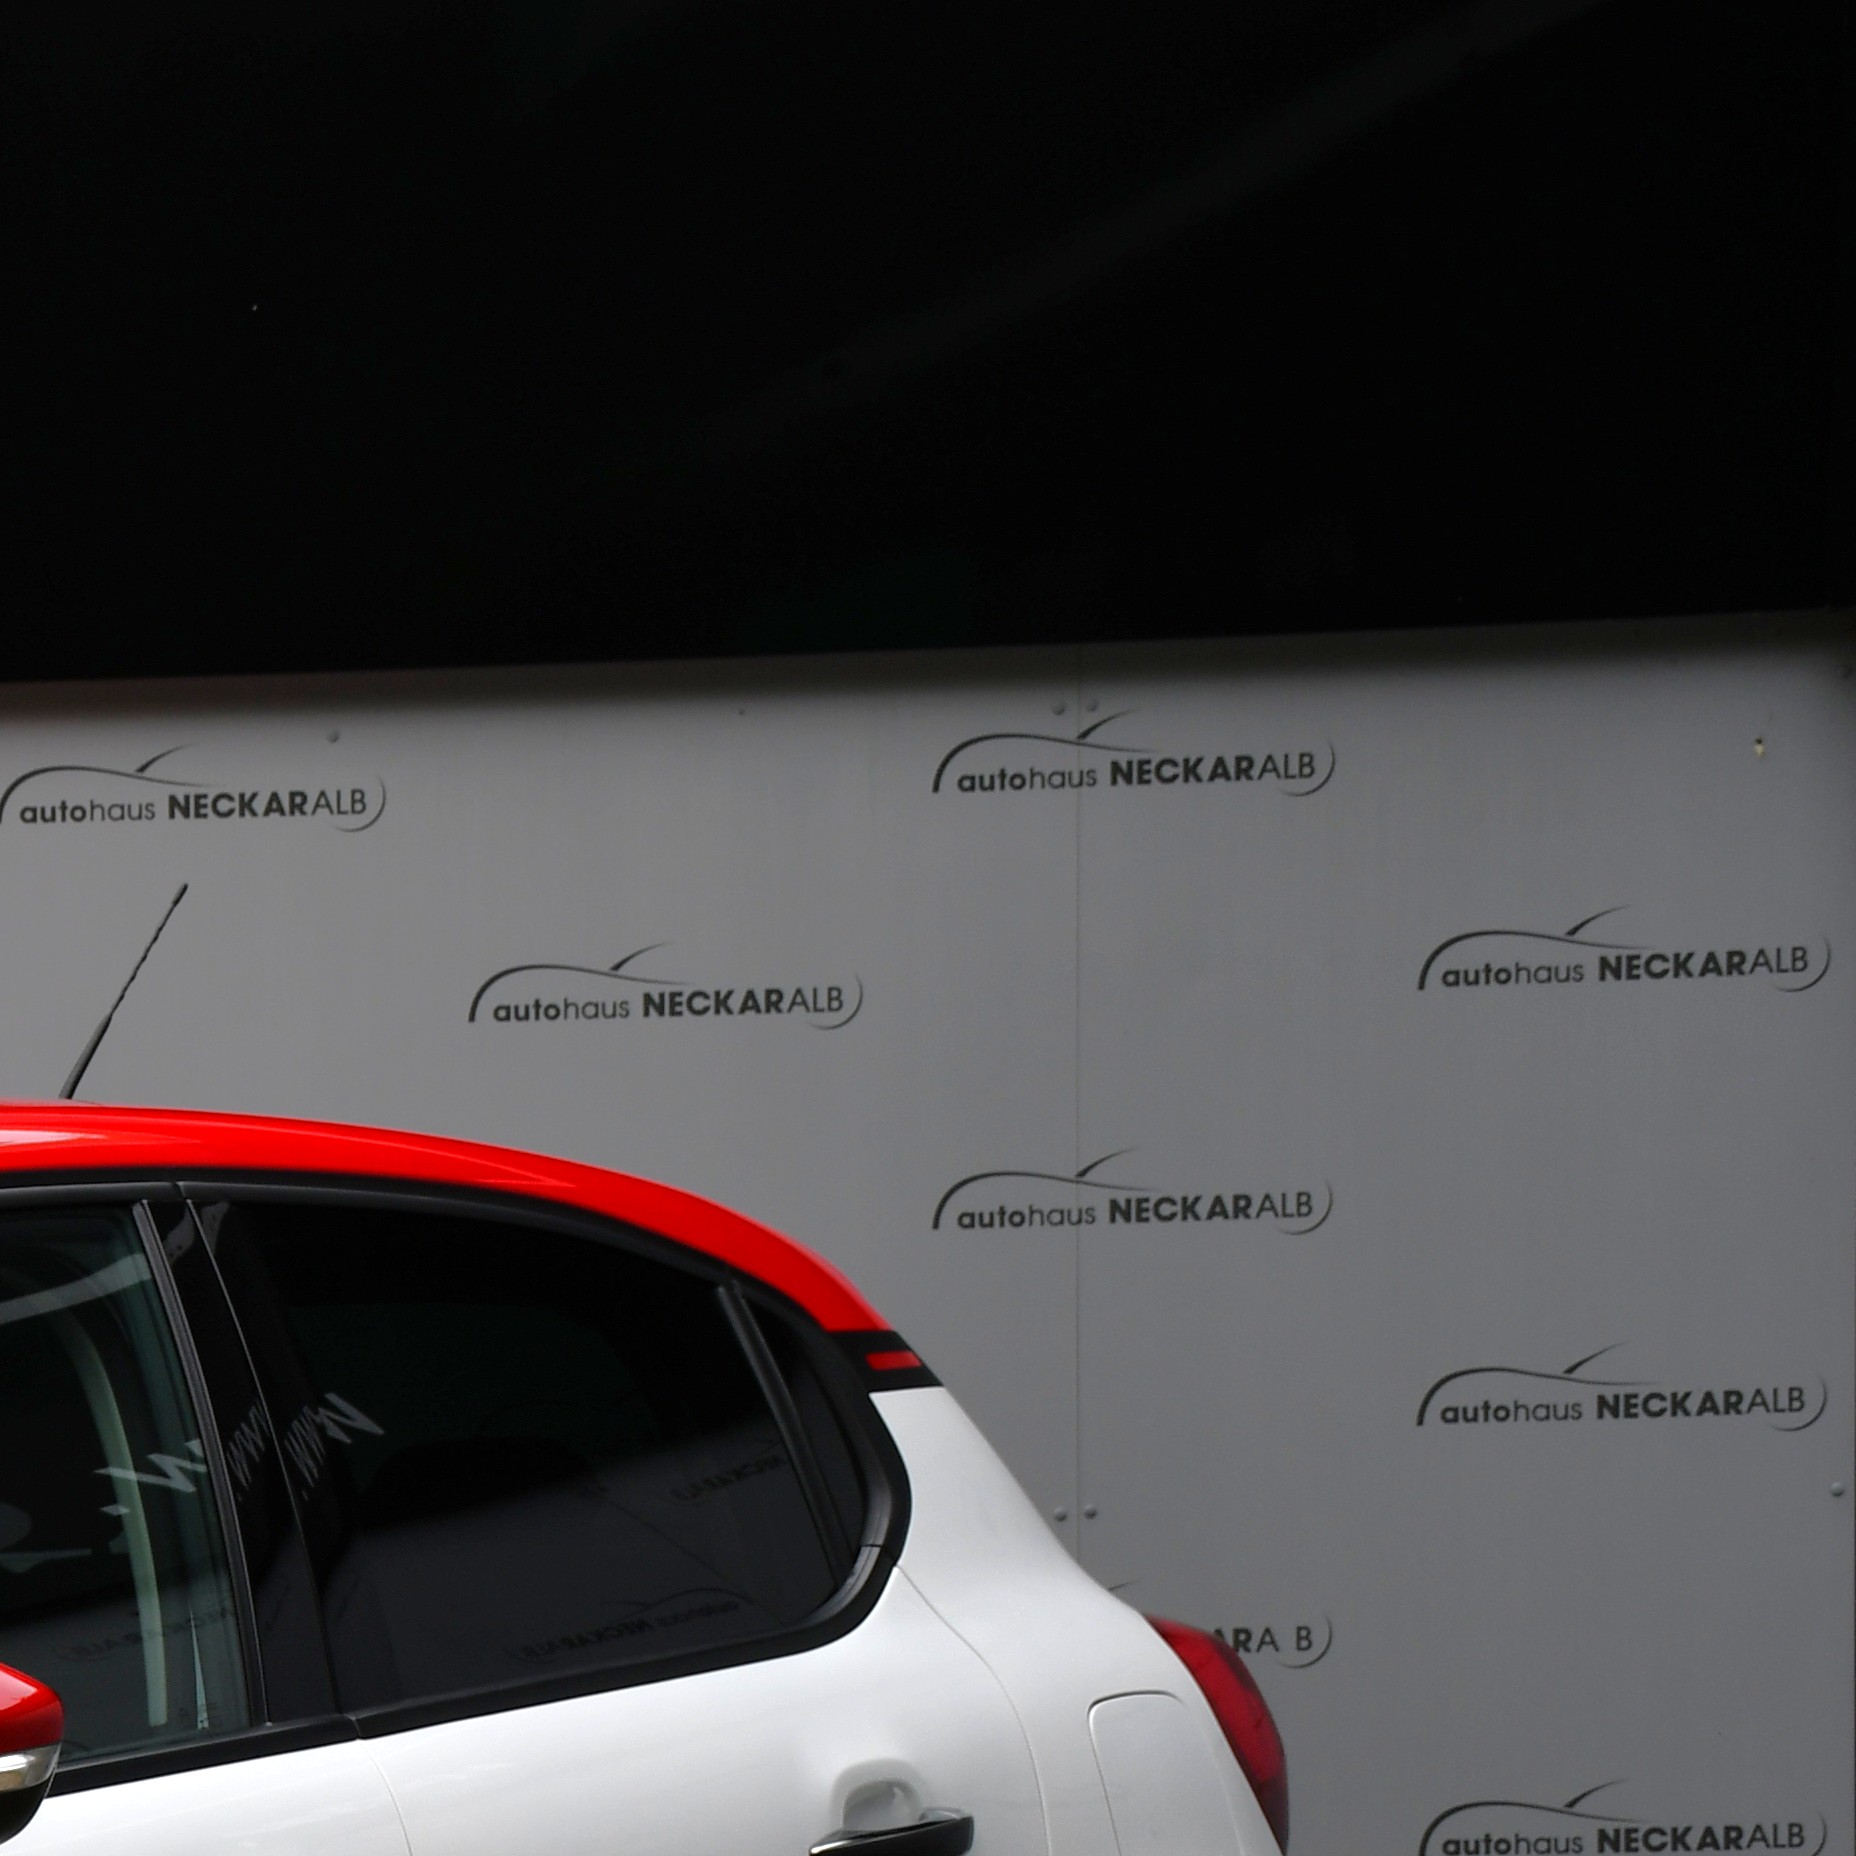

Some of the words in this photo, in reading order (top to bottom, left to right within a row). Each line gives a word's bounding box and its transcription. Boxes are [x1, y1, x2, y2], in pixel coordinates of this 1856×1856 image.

[957, 767, 1097, 793] autohaus
[1110, 752, 1315, 786] NECKARALB
[20, 800, 155, 824] autohaus
[168, 789, 367, 820] NECKARALB
[1441, 962, 1584, 987] autohaus
[1598, 946, 1808, 982] NECKARALB
[493, 998, 630, 1022] autohaus
[643, 986, 843, 1018] NECKARALB
[957, 1205, 1096, 1230] autohaus
[1109, 1191, 1312, 1224] NECKARALB
[1440, 1400, 1582, 1424] autohaus
[1597, 1387, 1805, 1420] NECKARALB
[1442, 1833, 1583, 1856] autohaus
[1597, 1822, 1805, 1854] NECKARALB
